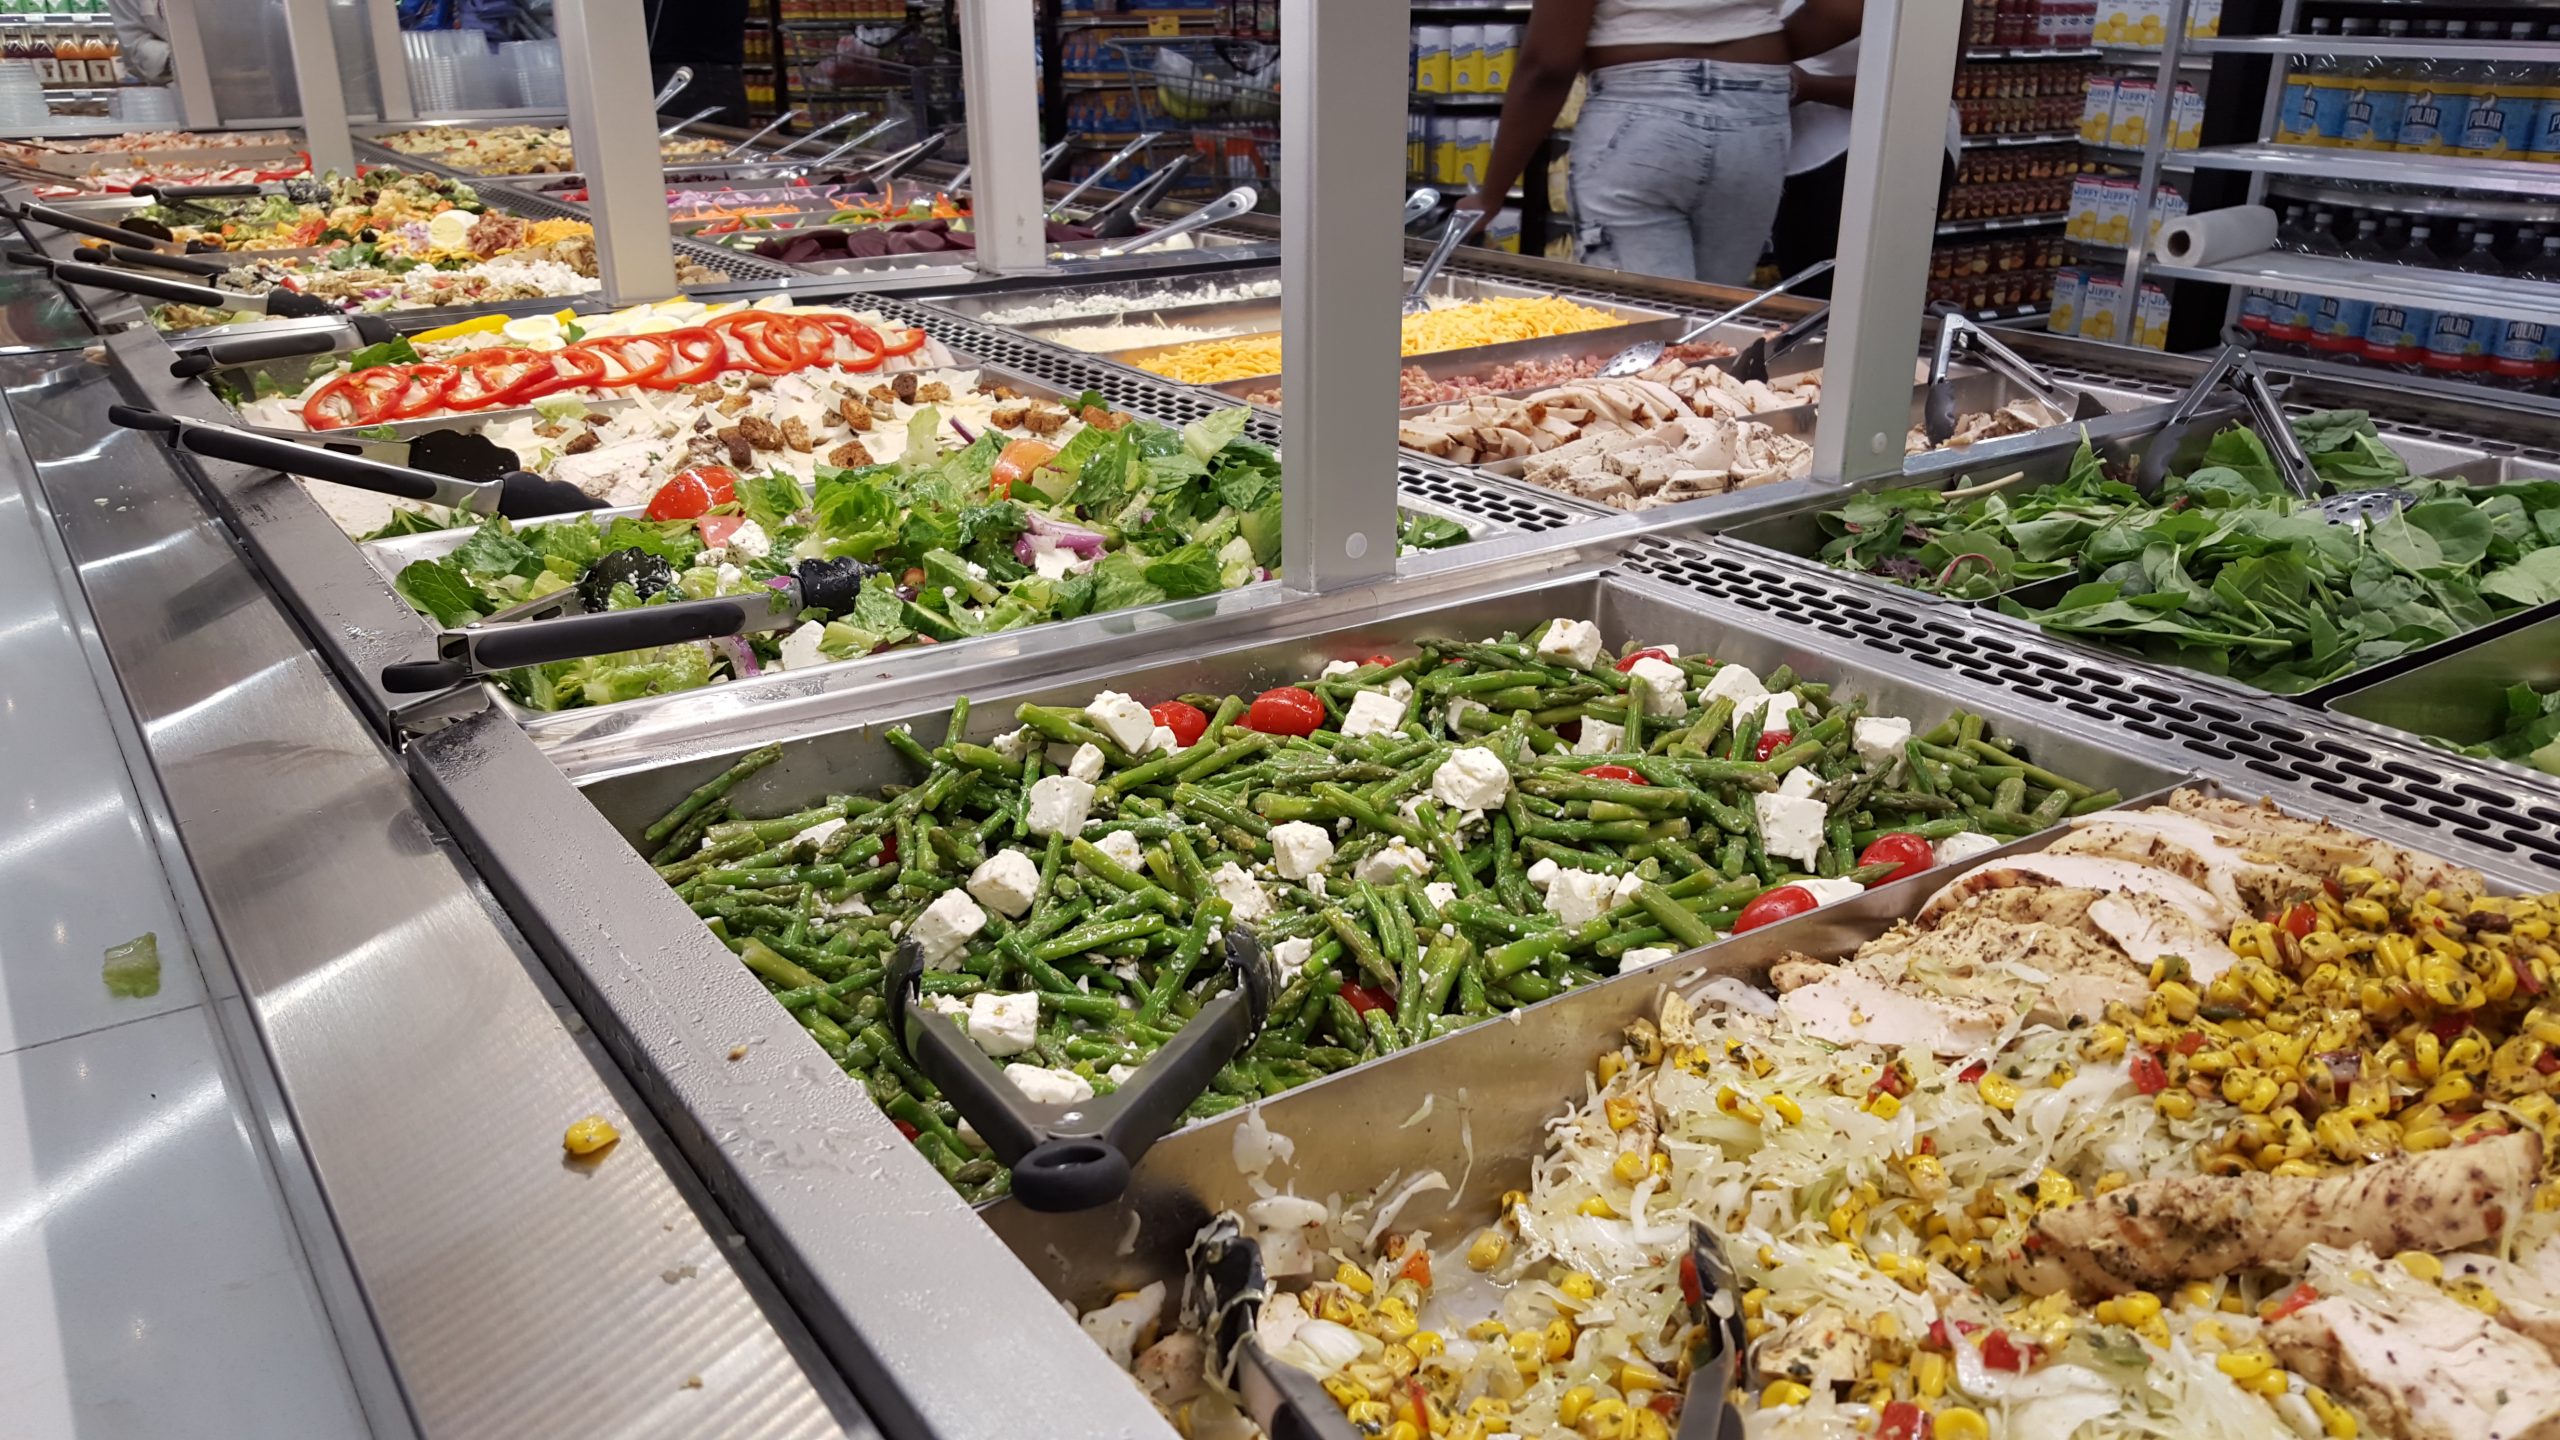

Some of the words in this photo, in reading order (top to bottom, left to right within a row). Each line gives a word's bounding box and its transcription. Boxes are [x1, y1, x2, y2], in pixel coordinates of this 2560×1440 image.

[2119, 90, 2146, 101] JIFFY
[2407, 106, 2438, 126] POLAR
[2469, 109, 2503, 131] POLAR
[2074, 187, 2099, 198] JIFFY
[2102, 189, 2131, 202] JIFFY
[2088, 285, 2115, 299] JIFFY
[2375, 308, 2405, 329] POLAR
[2437, 316, 2472, 337] POLAR
[2508, 322, 2545, 342] POLAR
